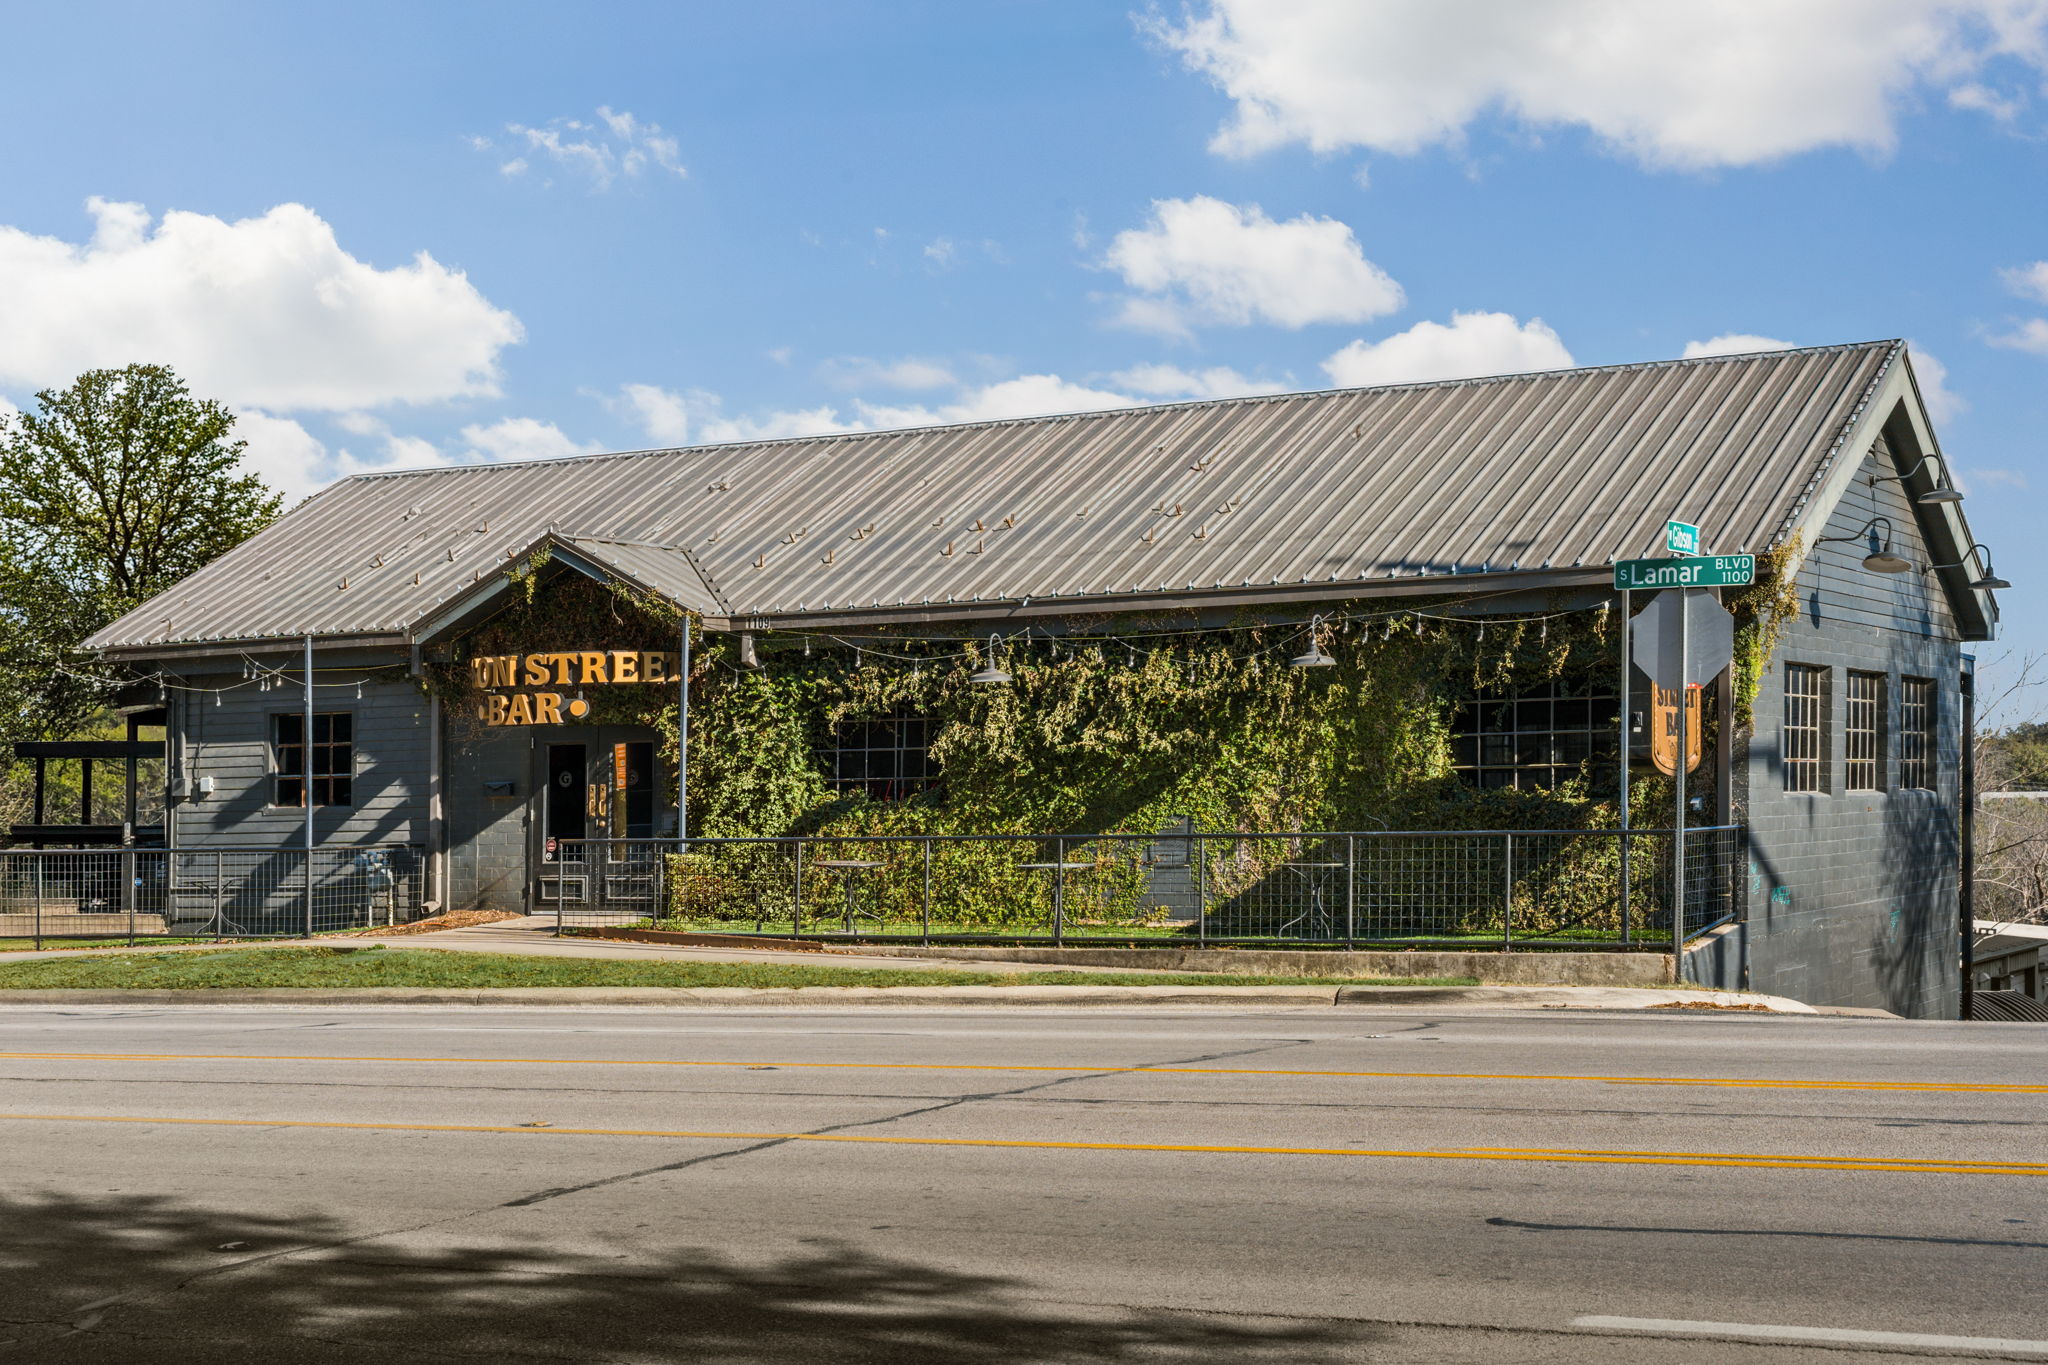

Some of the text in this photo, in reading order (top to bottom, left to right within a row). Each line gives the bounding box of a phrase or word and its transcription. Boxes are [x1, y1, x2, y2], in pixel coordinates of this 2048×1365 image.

[1673, 525, 1693, 550] Gibson
[1620, 558, 1750, 585] S Lamar BLVD
[1721, 571, 1750, 583] 1100
[746, 616, 770, 629] 1109
[487, 692, 564, 726] BAR
